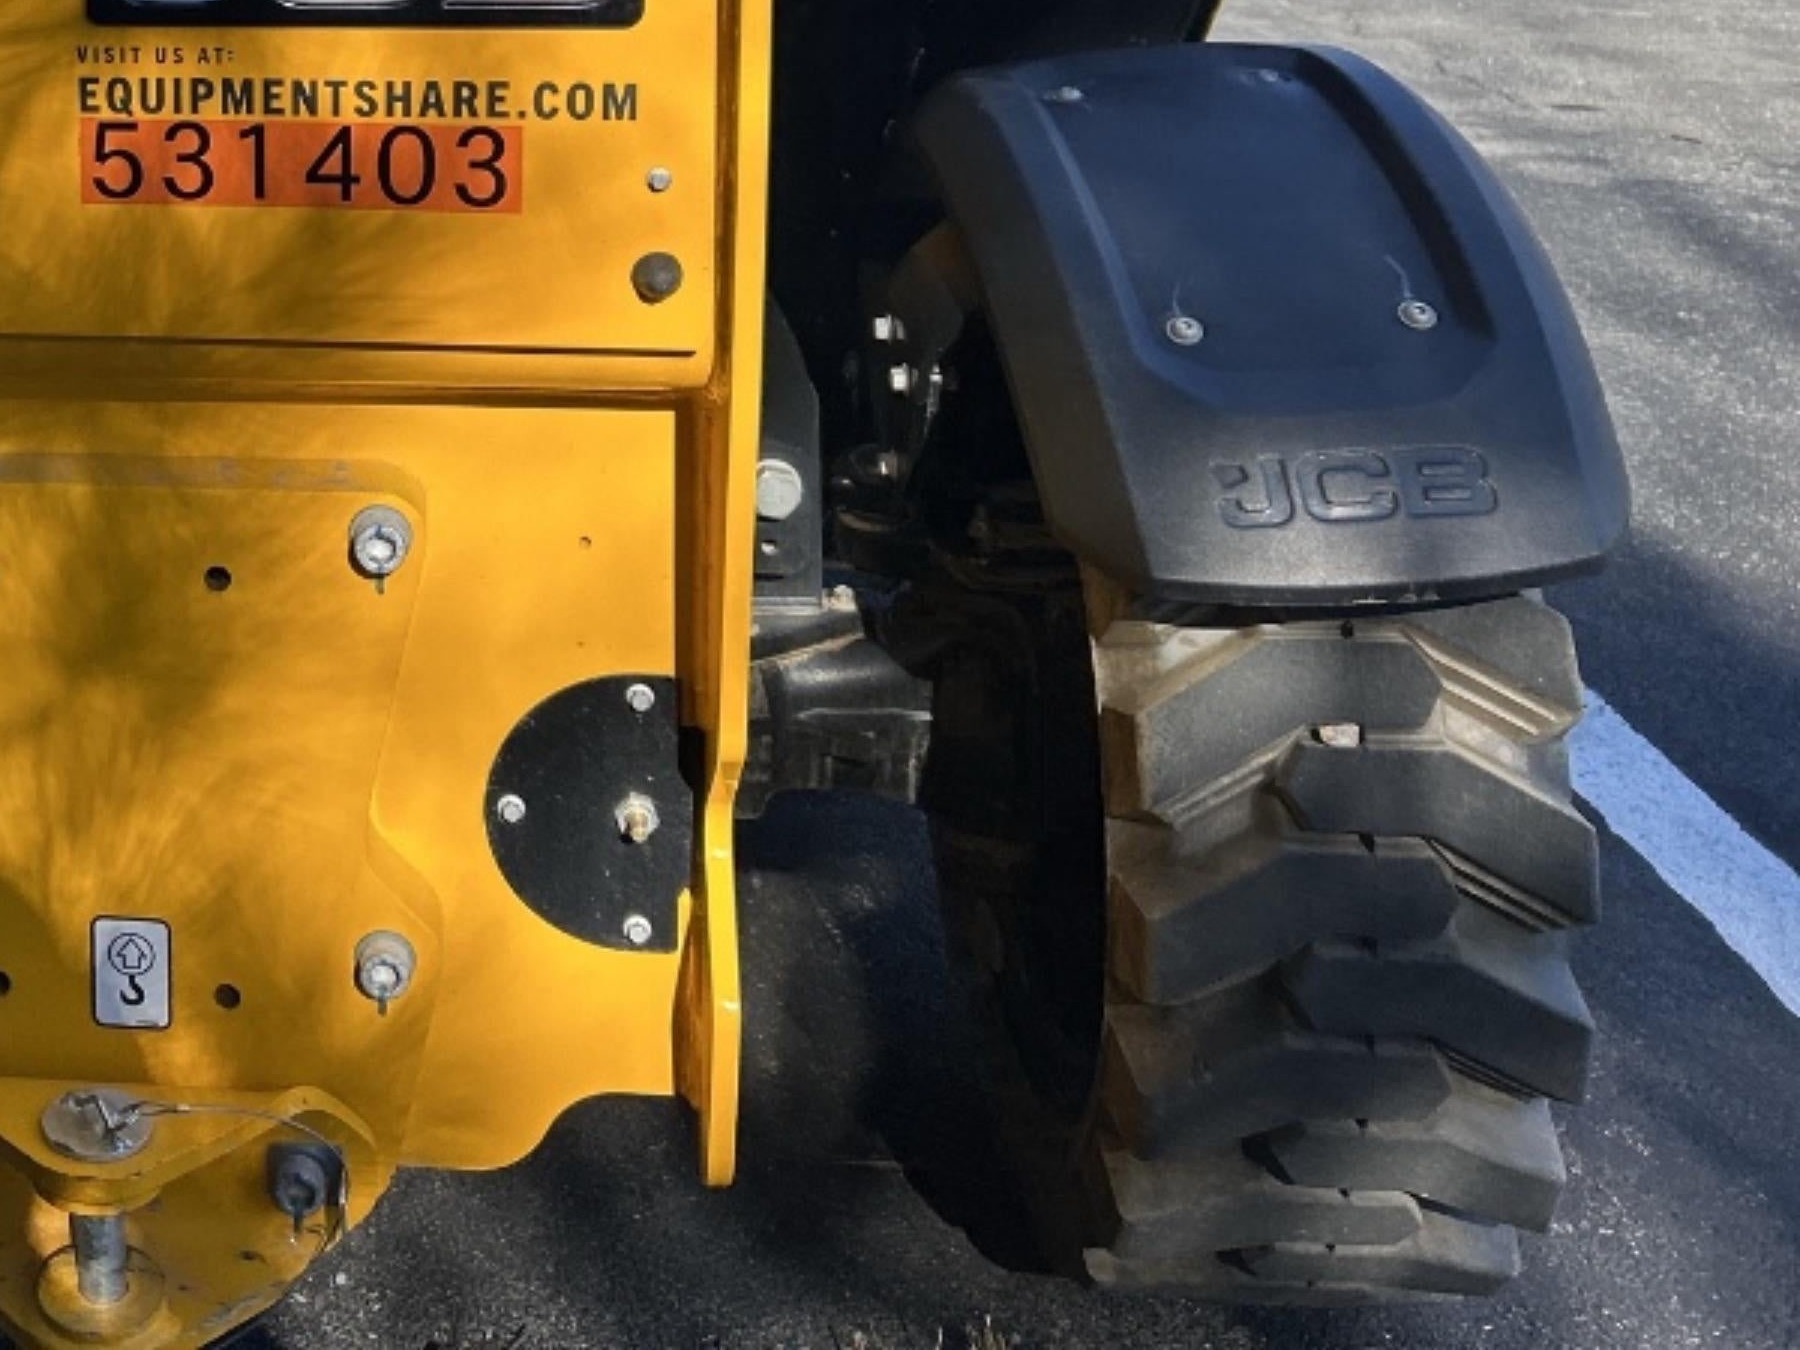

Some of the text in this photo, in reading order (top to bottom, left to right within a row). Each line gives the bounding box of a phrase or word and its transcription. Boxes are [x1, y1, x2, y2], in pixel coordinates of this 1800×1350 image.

[77, 45, 234, 65] VISIT US AT:
[78, 77, 638, 121] EQUIPMENTSHARE.COM
[92, 121, 507, 207] 531403
[1210, 446, 1499, 529] JCB
